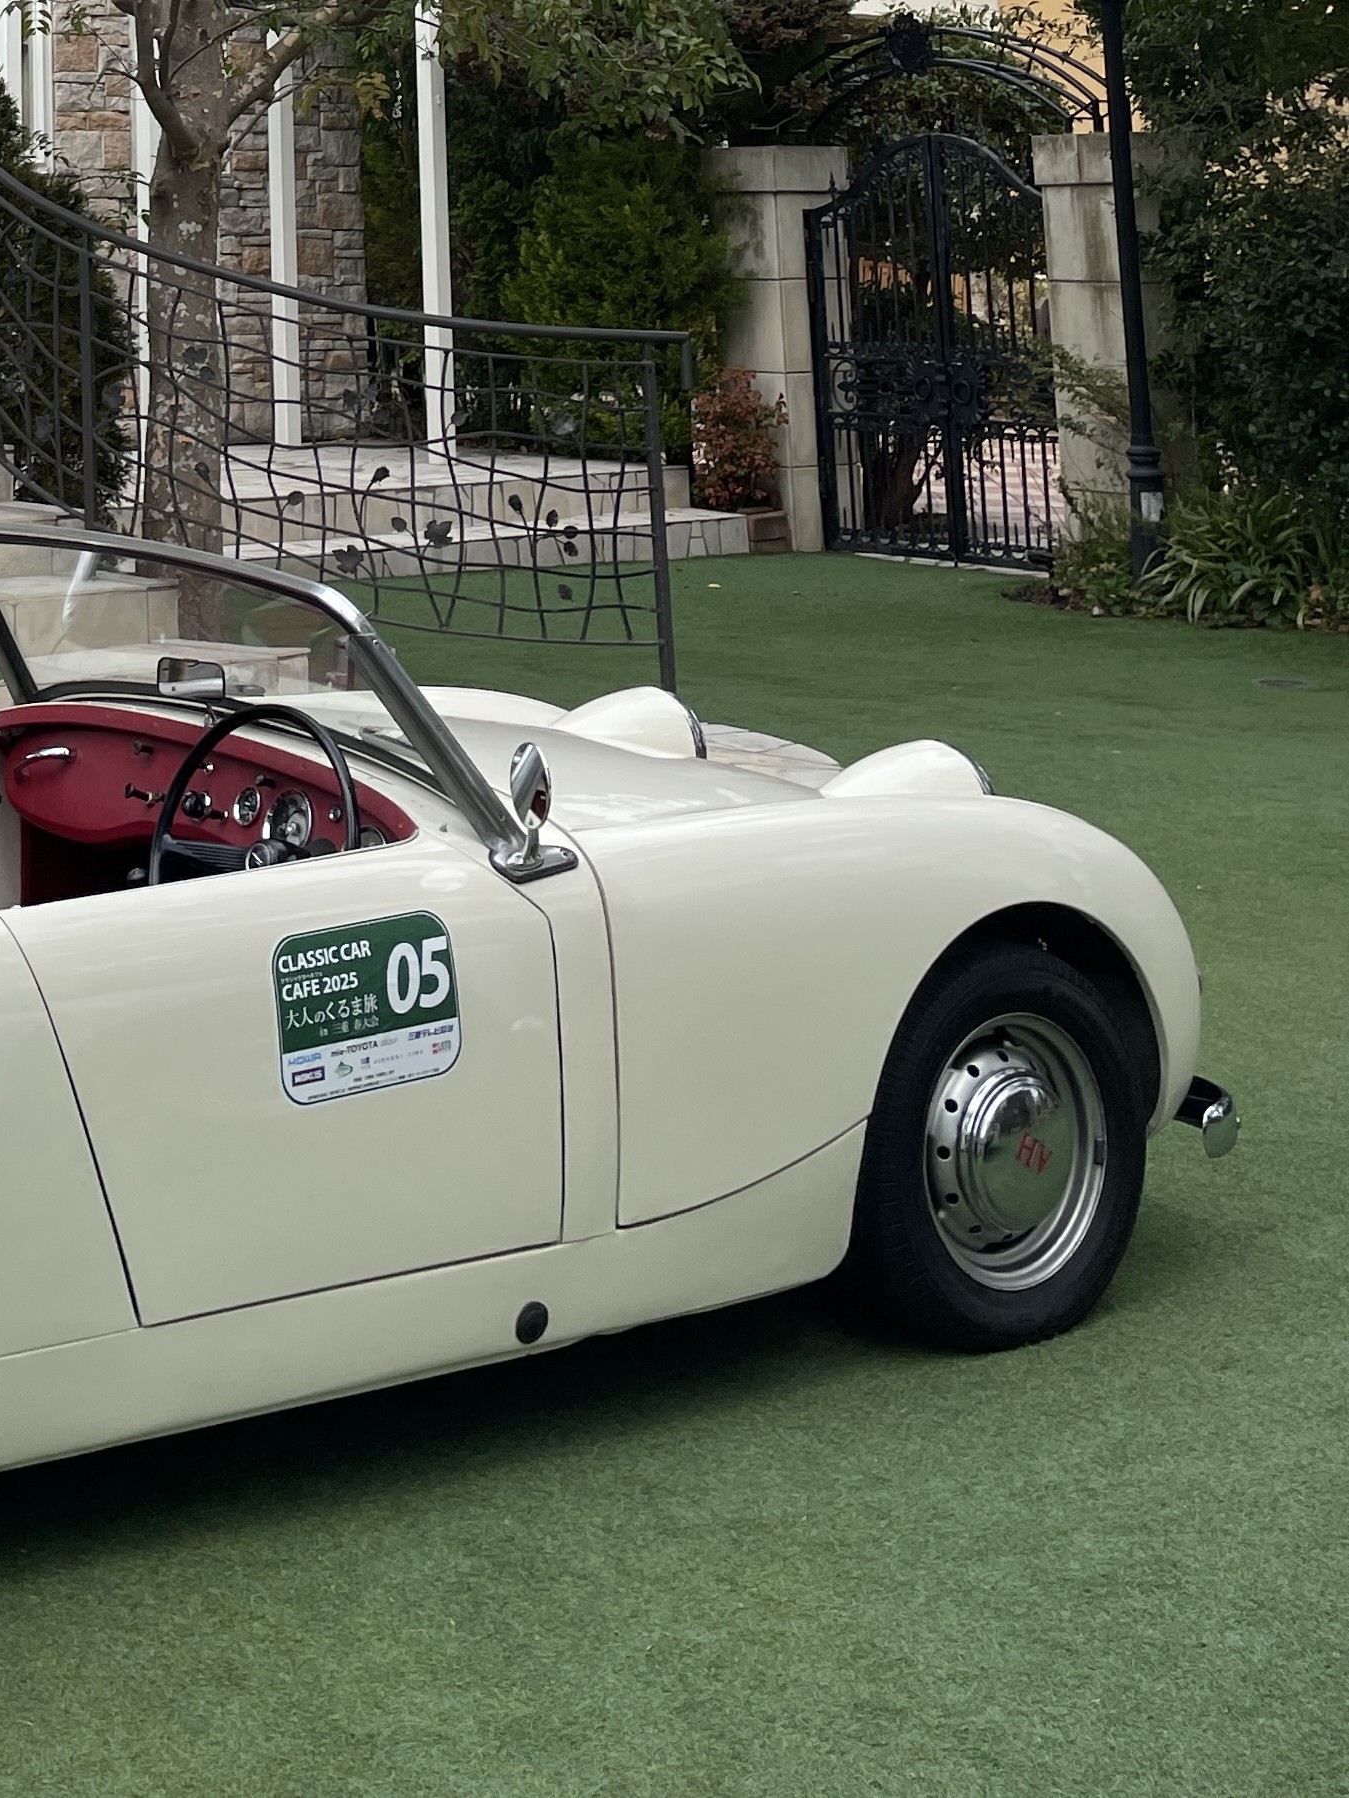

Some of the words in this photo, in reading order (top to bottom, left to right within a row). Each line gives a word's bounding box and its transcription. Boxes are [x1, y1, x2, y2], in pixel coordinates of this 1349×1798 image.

[278, 945, 340, 973] CLASSIC
[340, 940, 372, 961] CAR
[282, 979, 321, 1001] CAFE
[323, 971, 359, 994] 2025
[386, 935, 451, 1015] 05
[285, 993, 379, 1031] 大人のくるま旅
